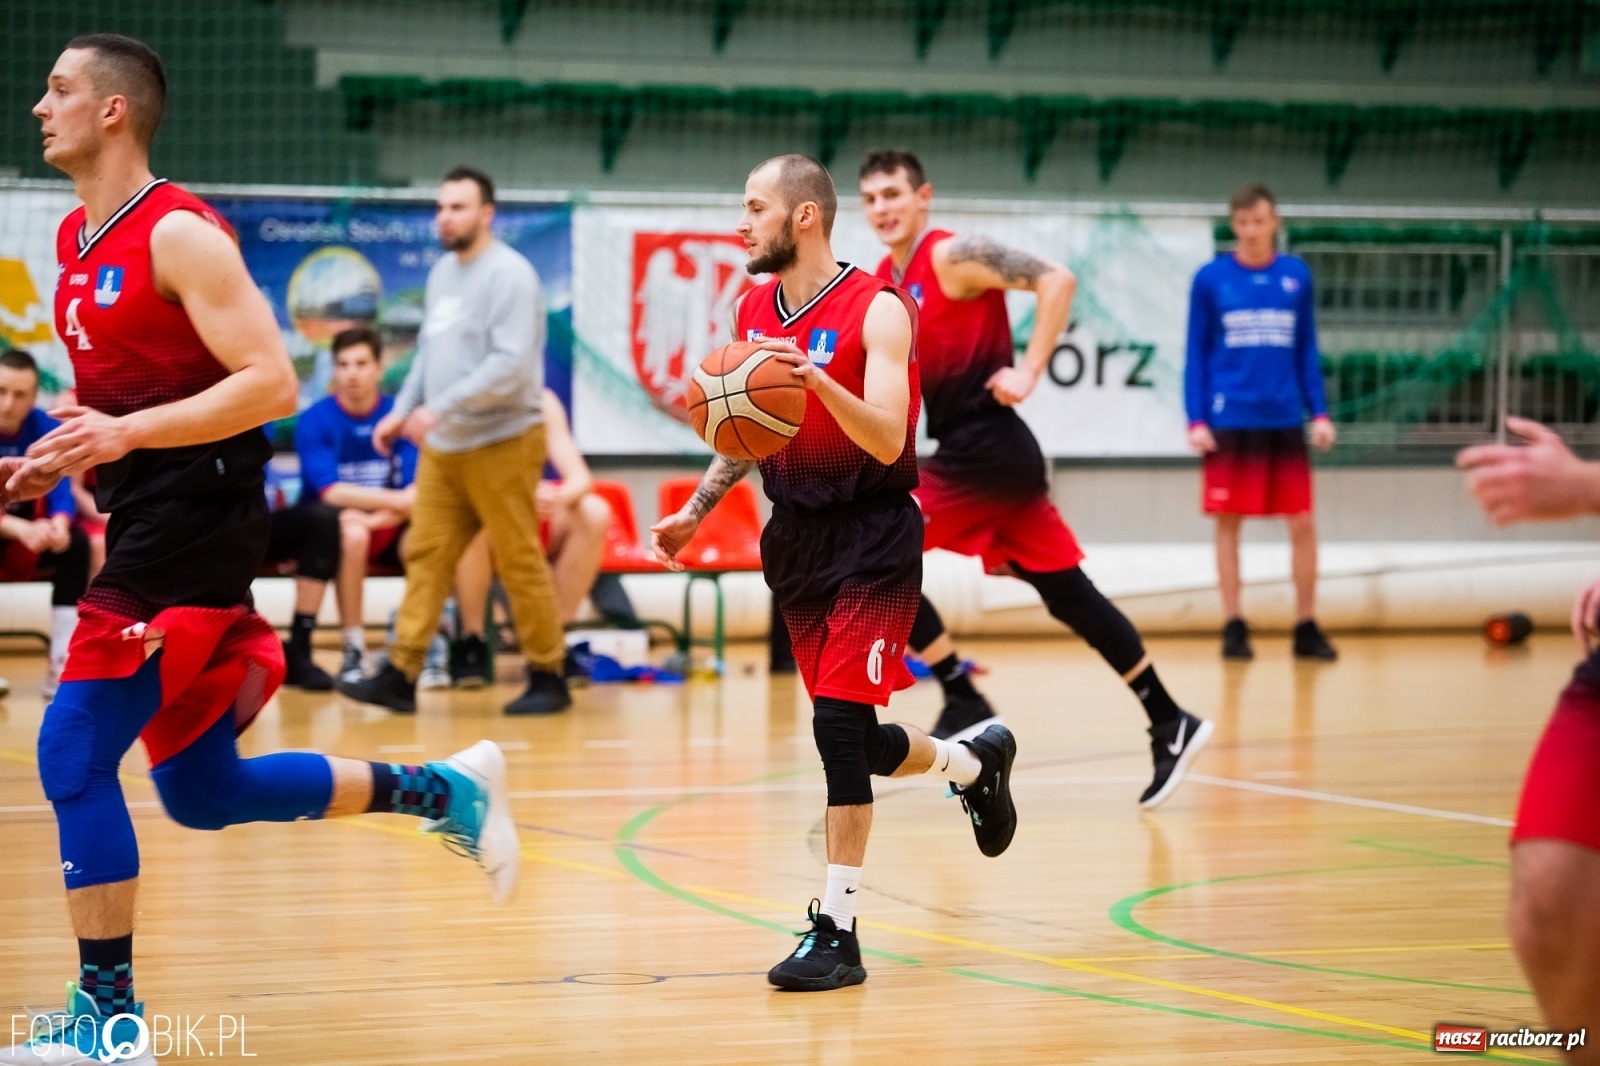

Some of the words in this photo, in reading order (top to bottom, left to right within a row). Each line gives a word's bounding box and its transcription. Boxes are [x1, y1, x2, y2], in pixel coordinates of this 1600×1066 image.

[65, 297, 93, 350] 4
[1047, 320, 1156, 387] órz
[867, 638, 886, 685] 6
